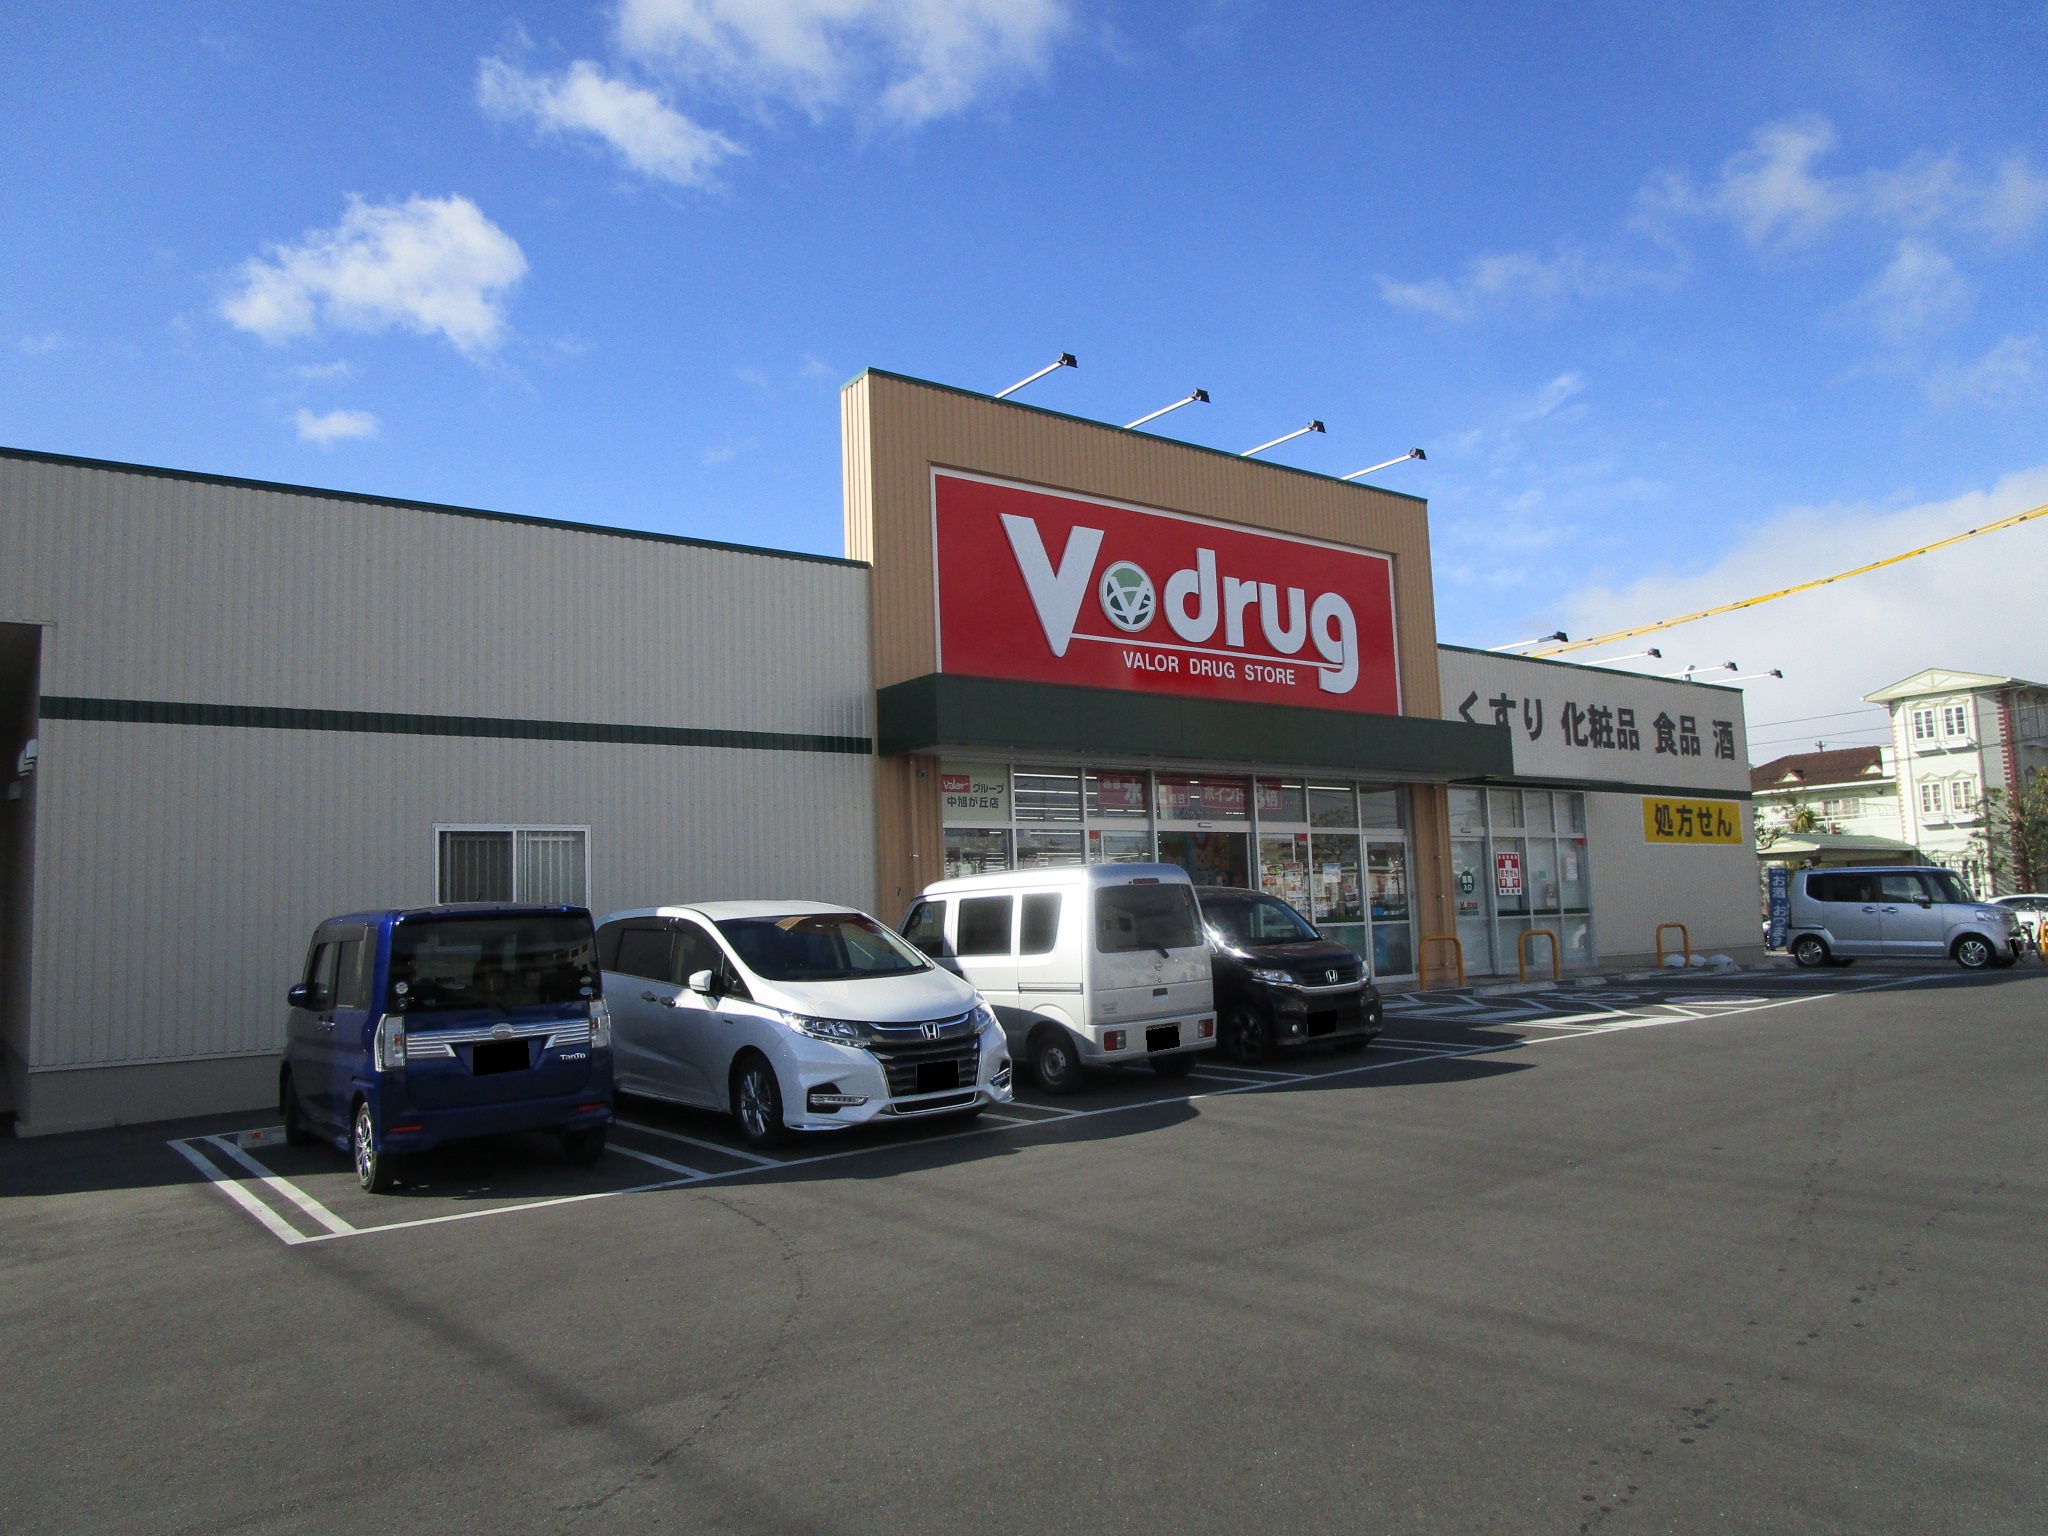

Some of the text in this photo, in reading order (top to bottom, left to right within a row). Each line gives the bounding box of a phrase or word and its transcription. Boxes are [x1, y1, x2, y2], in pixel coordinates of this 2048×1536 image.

[1123, 650, 1296, 686] VALOR DRUG STORE
[1458, 690, 1736, 761] くすり 化粧品 食品 酒
[947, 795, 999, 809] 中旭が丘店
[972, 783, 1006, 795] グループ
[1654, 802, 1733, 838] 処方せん
